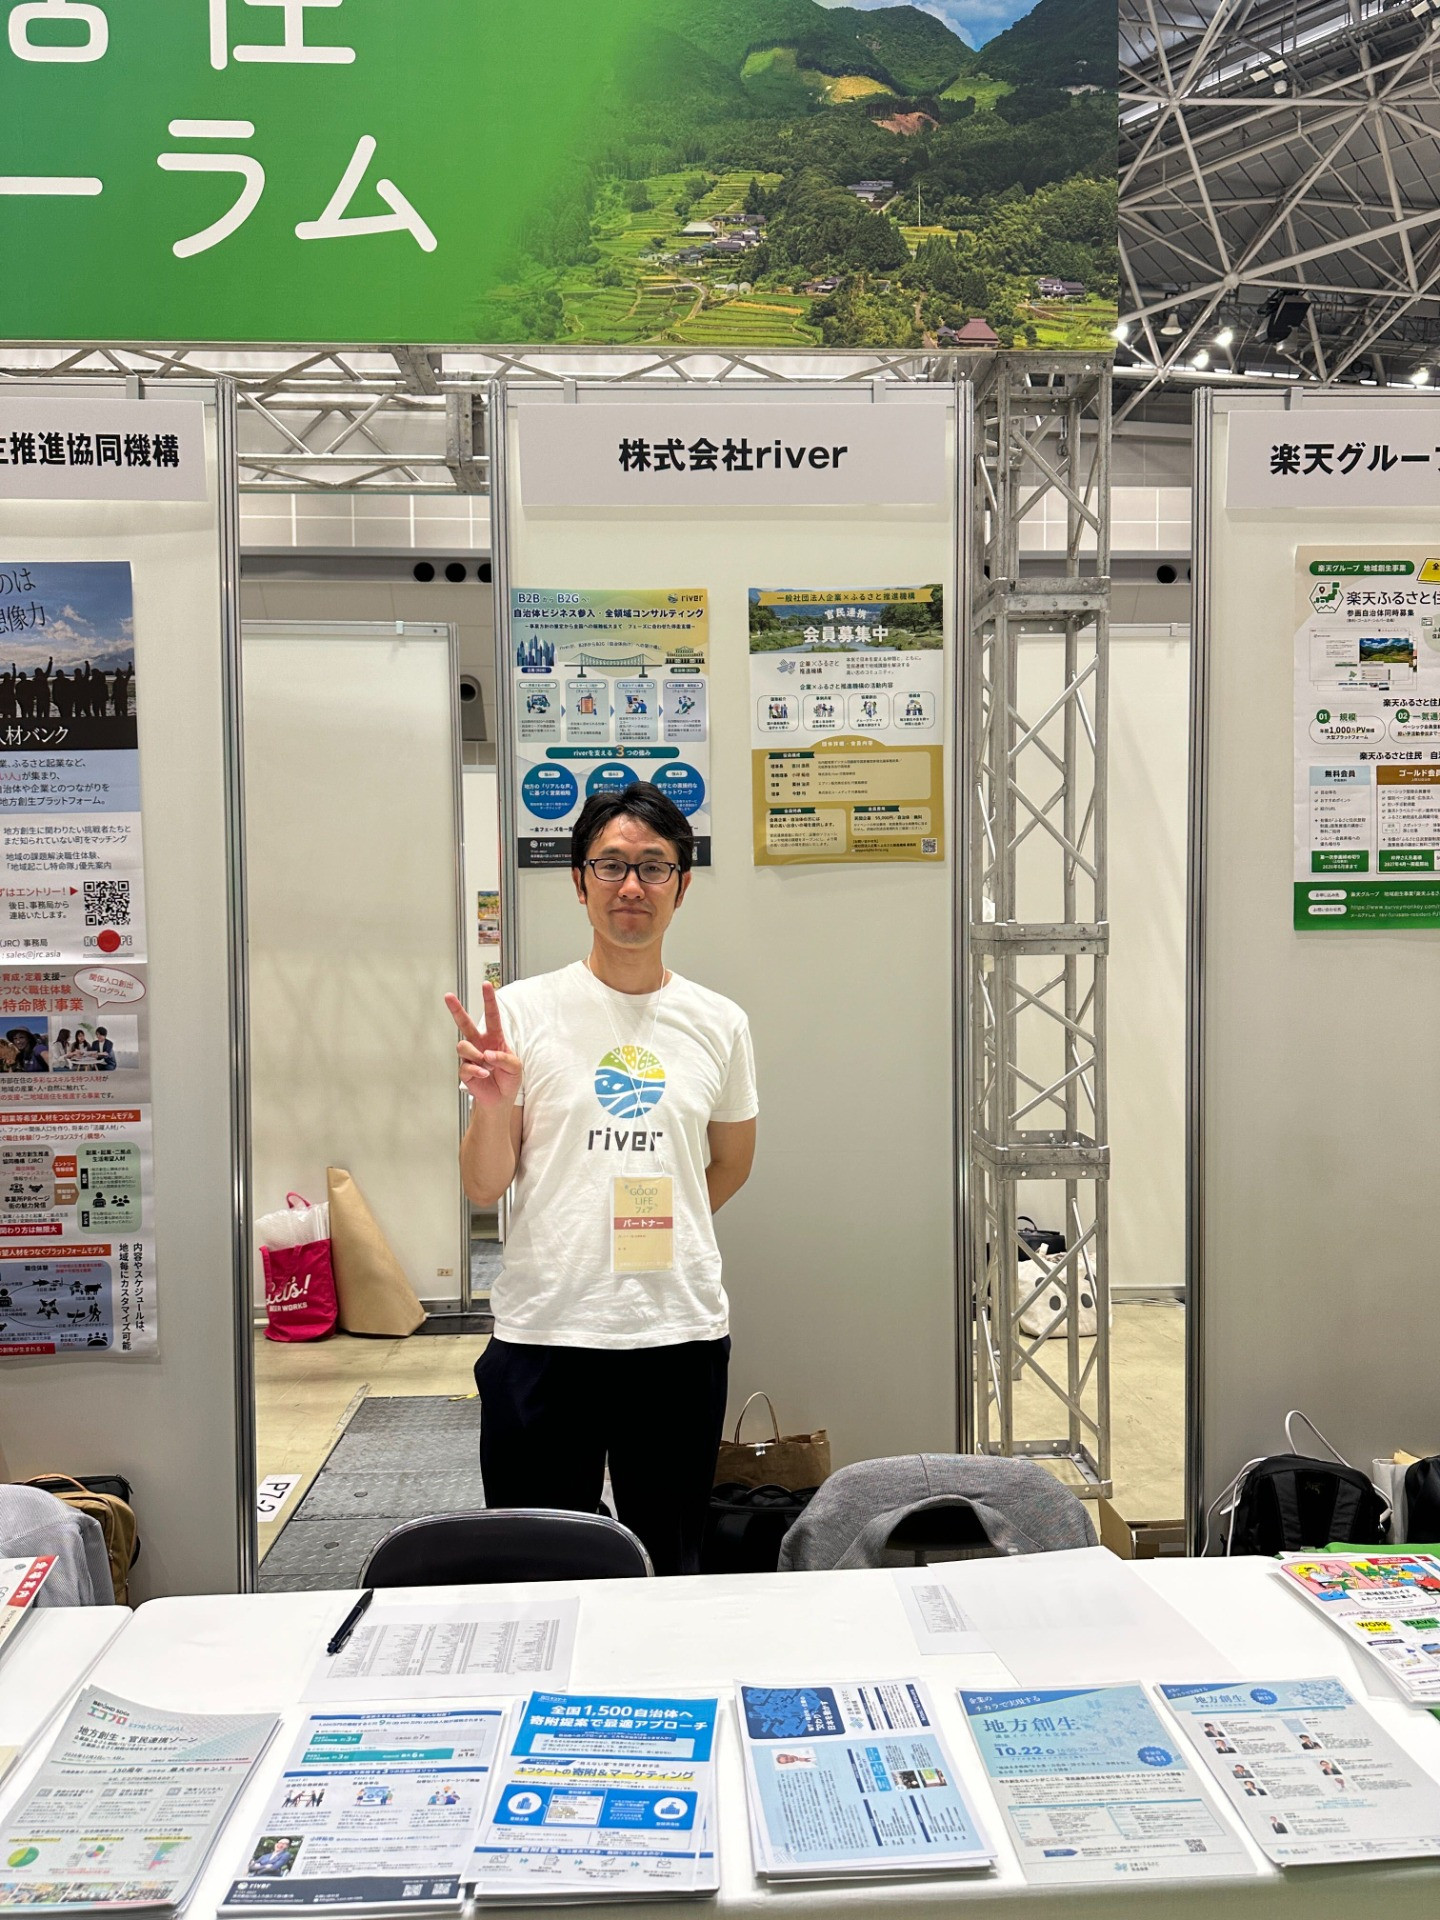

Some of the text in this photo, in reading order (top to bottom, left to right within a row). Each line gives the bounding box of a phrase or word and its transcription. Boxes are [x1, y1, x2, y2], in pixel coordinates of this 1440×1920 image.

[0, 432, 180, 468] 推進協同機構
[619, 438, 848, 472] 株式会社river
[1270, 441, 1440, 475] 楽天グルー
[1318, 564, 1360, 572] 楽天グループ
[681, 594, 703, 602] river
[777, 591, 916, 602] 一般社団法人企業×ふるさと推進機構
[803, 625, 889, 644] 会員募集中
[1383, 698, 1440, 707] 楽天ふるさと住
[1340, 713, 1357, 721] 規模
[0, 725, 69, 745] 材バンク
[1360, 751, 1422, 760] 楽天ふるさと住民
[1325, 769, 1355, 777] 無料会員
[0, 783, 110, 793] 治体や企業とのつながりを
[92, 985, 127, 997] プログラム
[0, 998, 84, 1013] 特命隊」事業
[588, 1127, 663, 1151] river
[630, 1186, 658, 1196] GOOD
[634, 1197, 653, 1206] LIFE
[636, 1206, 653, 1214] フェア
[623, 1219, 664, 1228] パートナー
[0, 1248, 105, 1256] 望人材をつなぐプラットフォームモデル
[282, 1302, 308, 1311] WORKS
[257, 1482, 291, 1513] P7-2
[1194, 1694, 1246, 1704] 地方創生
[87, 1706, 128, 1725] エコプロ
[551, 1704, 694, 1718] 全国1,500自治体へ
[529, 1715, 708, 1731] 寄附提案で最適アプローチ
[983, 1716, 1081, 1733] 地方創生
[78, 1725, 198, 1744] 地方創生・官民連携ゾーン
[996, 1747, 1044, 1756] 10.22
[249, 1882, 271, 1890] river
